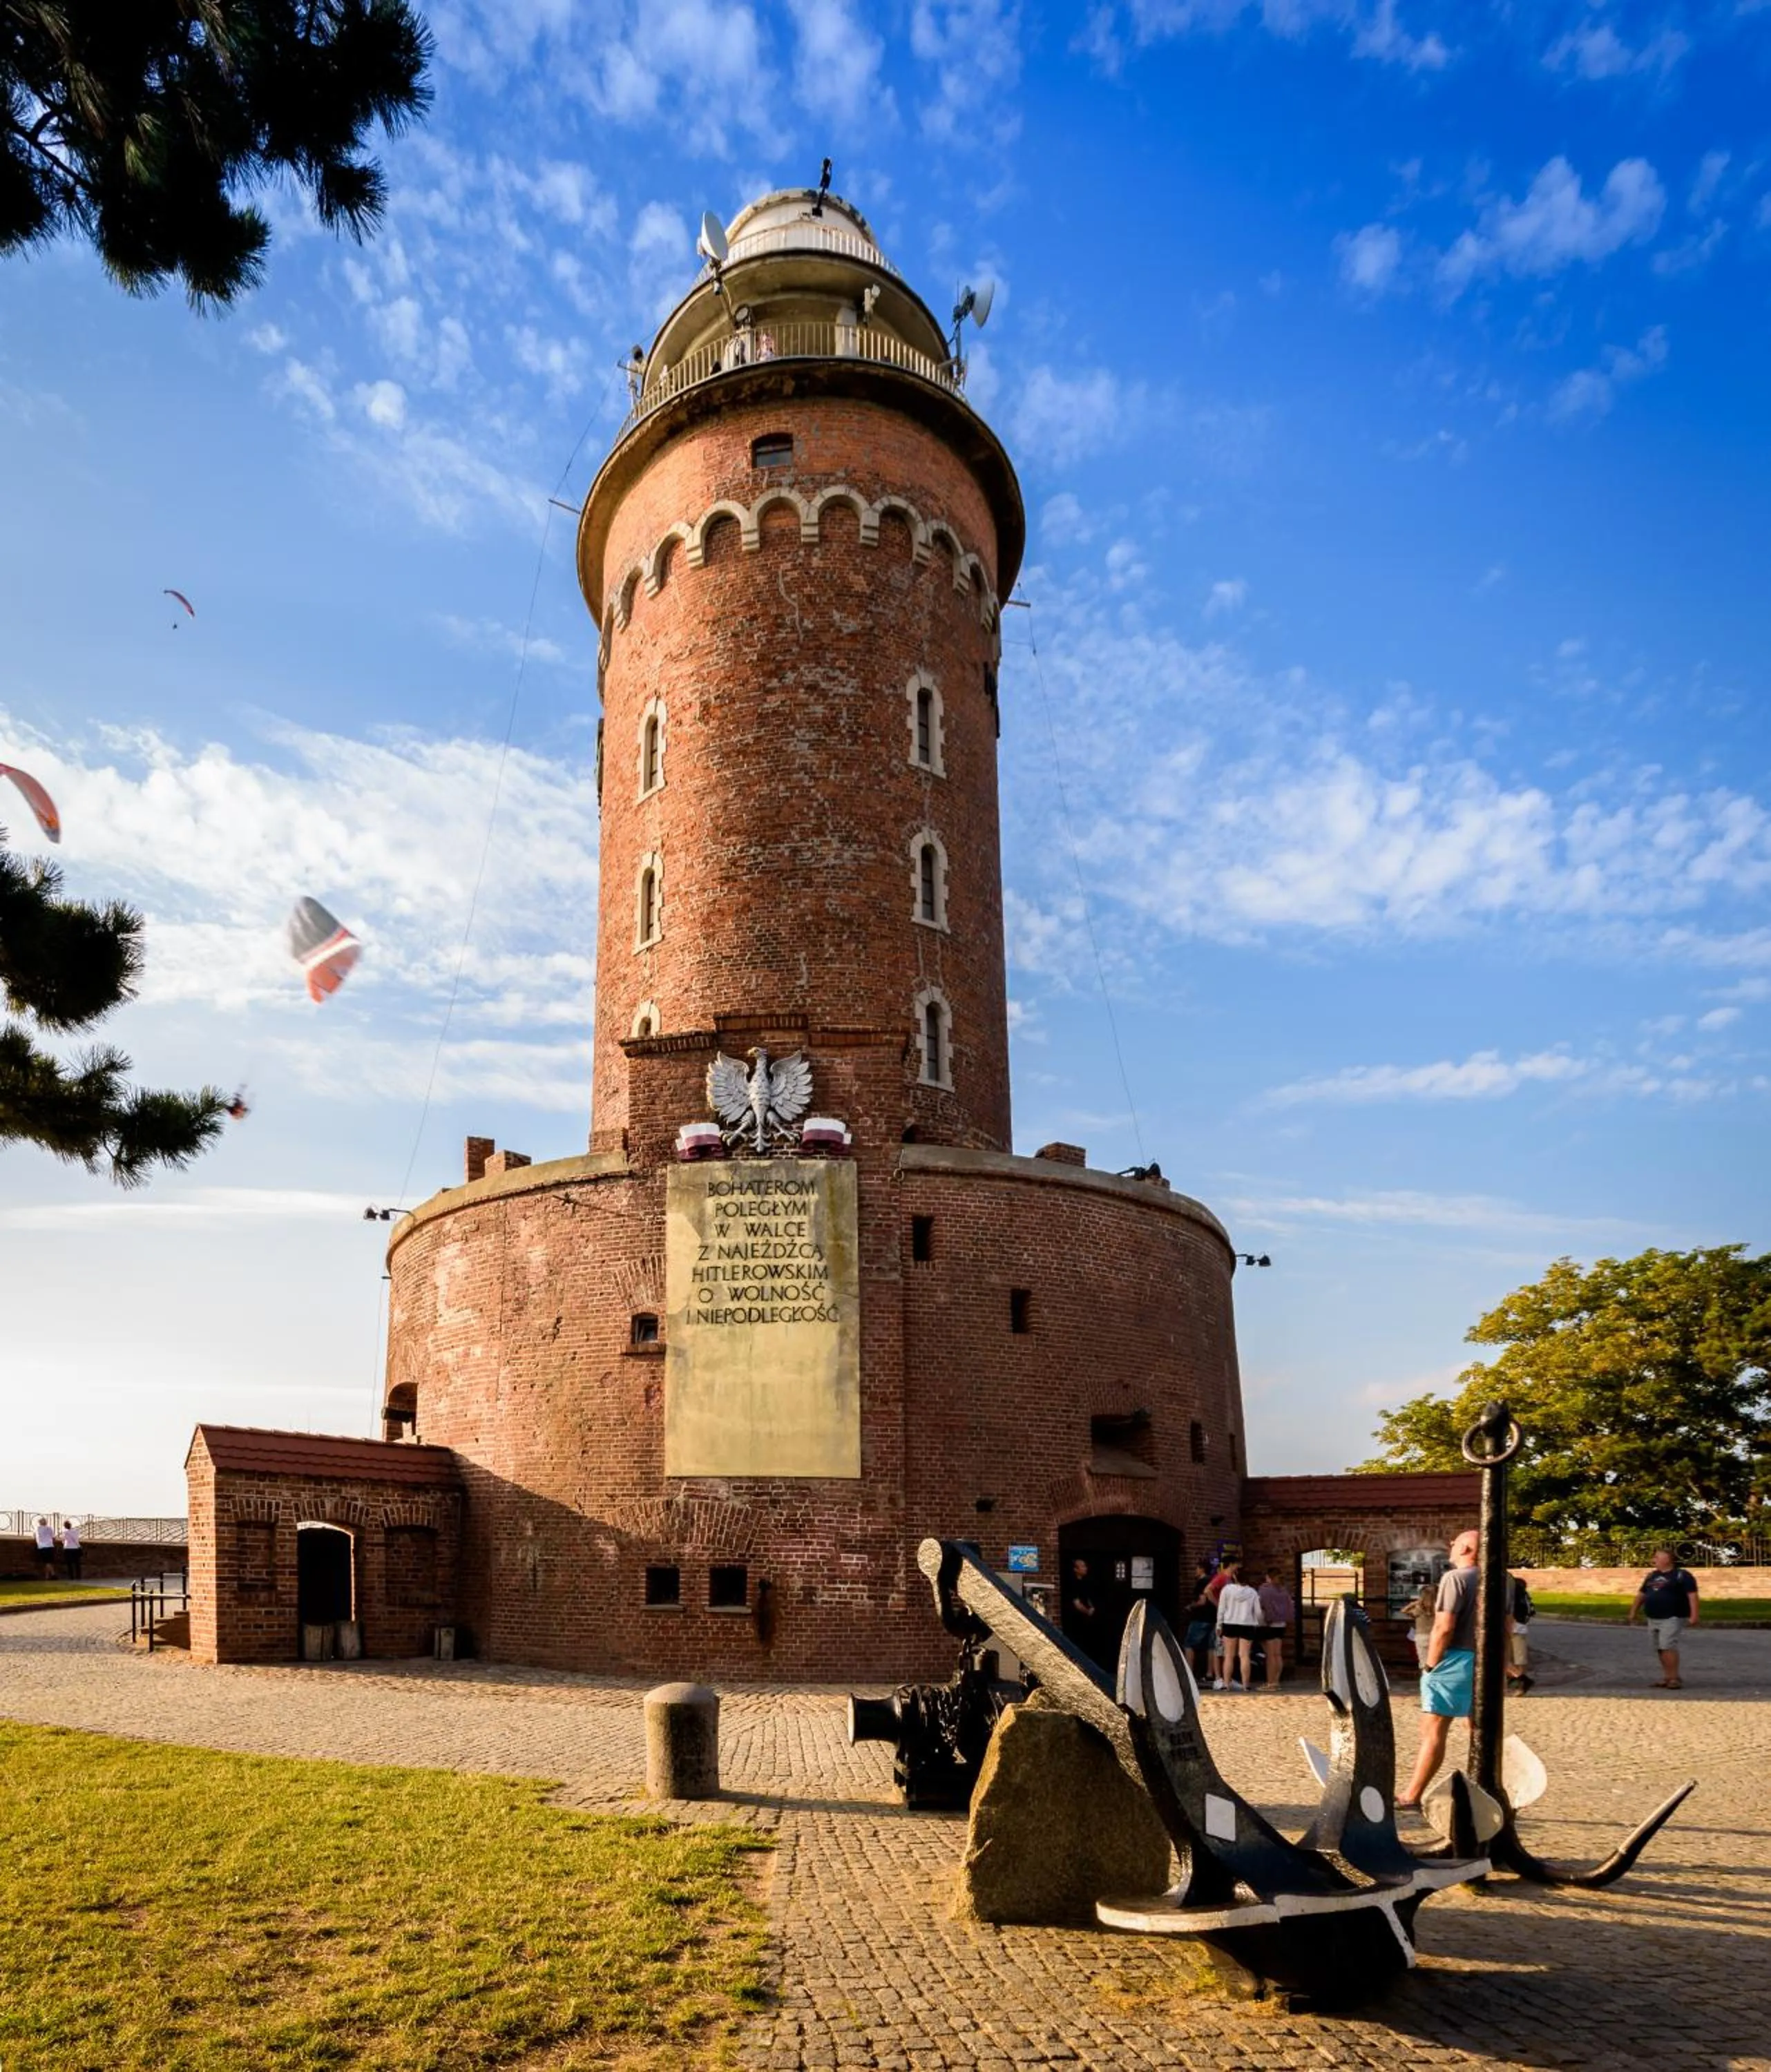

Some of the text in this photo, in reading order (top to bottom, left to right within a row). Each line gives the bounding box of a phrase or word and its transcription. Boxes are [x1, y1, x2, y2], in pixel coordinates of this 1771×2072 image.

[707, 1180, 815, 1198] BOHATEROM
[715, 1200, 807, 1217] POLEGŁYM
[714, 1222, 806, 1238] W WALCE
[698, 1239, 824, 1261] Z NAJEŹDŹCĄ
[691, 1264, 829, 1282] HITLEROWSKIM
[698, 1281, 825, 1303] O WOLNOŚĆ
[697, 1303, 841, 1325] NIEPODLEGŁOŚĆ
